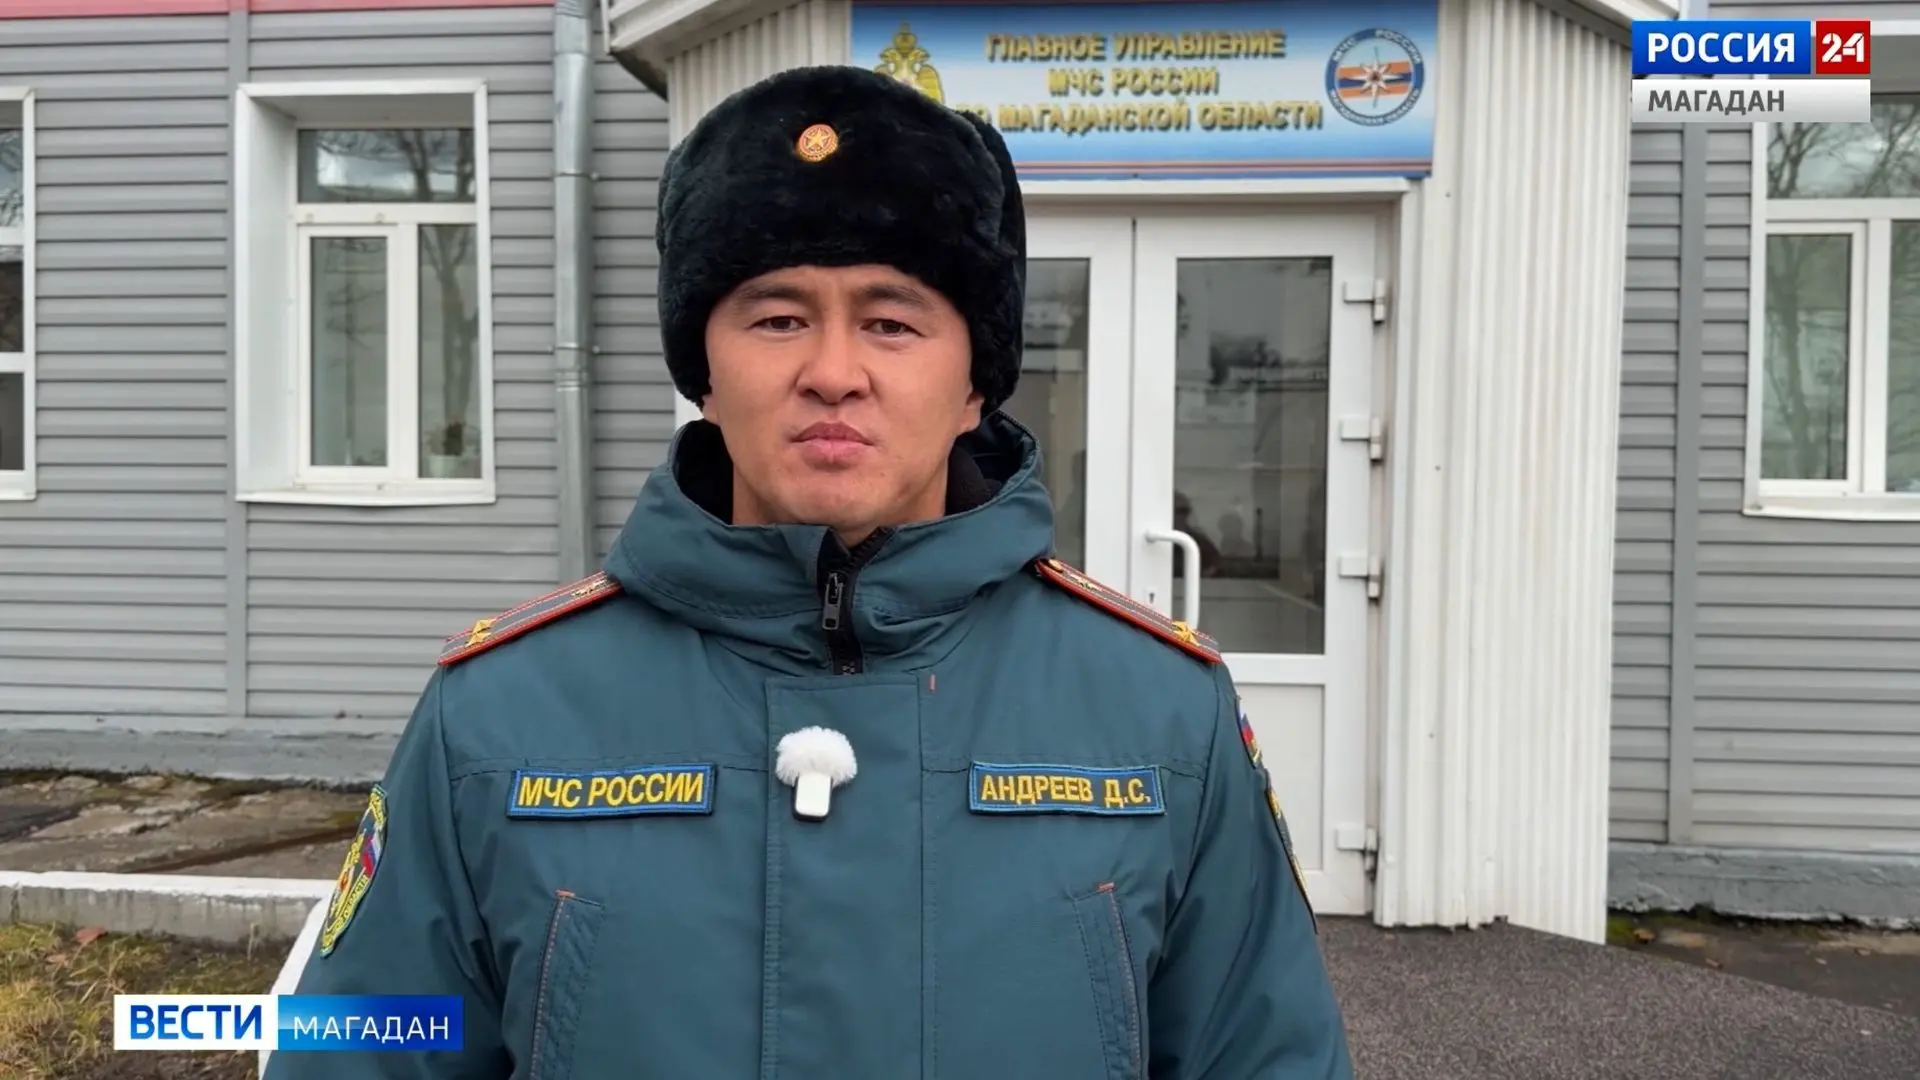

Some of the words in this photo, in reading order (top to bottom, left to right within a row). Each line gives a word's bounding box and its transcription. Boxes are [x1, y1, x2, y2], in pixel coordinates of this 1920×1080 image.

[985, 33, 1106, 61] ГЛАВНОЕ
[1113, 29, 1286, 60] УПРАВЛЕНИЕ
[1048, 68, 1104, 97] МЧС
[1112, 66, 1219, 96] РОССИИ
[999, 98, 1191, 136] МАГАДАНСКОЙ
[1199, 102, 1323, 132] ОБЛАСТИ
[518, 776, 582, 808] МЧС
[587, 772, 704, 806] РОССИИ
[981, 775, 1094, 805] АНДРЕЕВ
[1104, 778, 1151, 808] Д.С.
